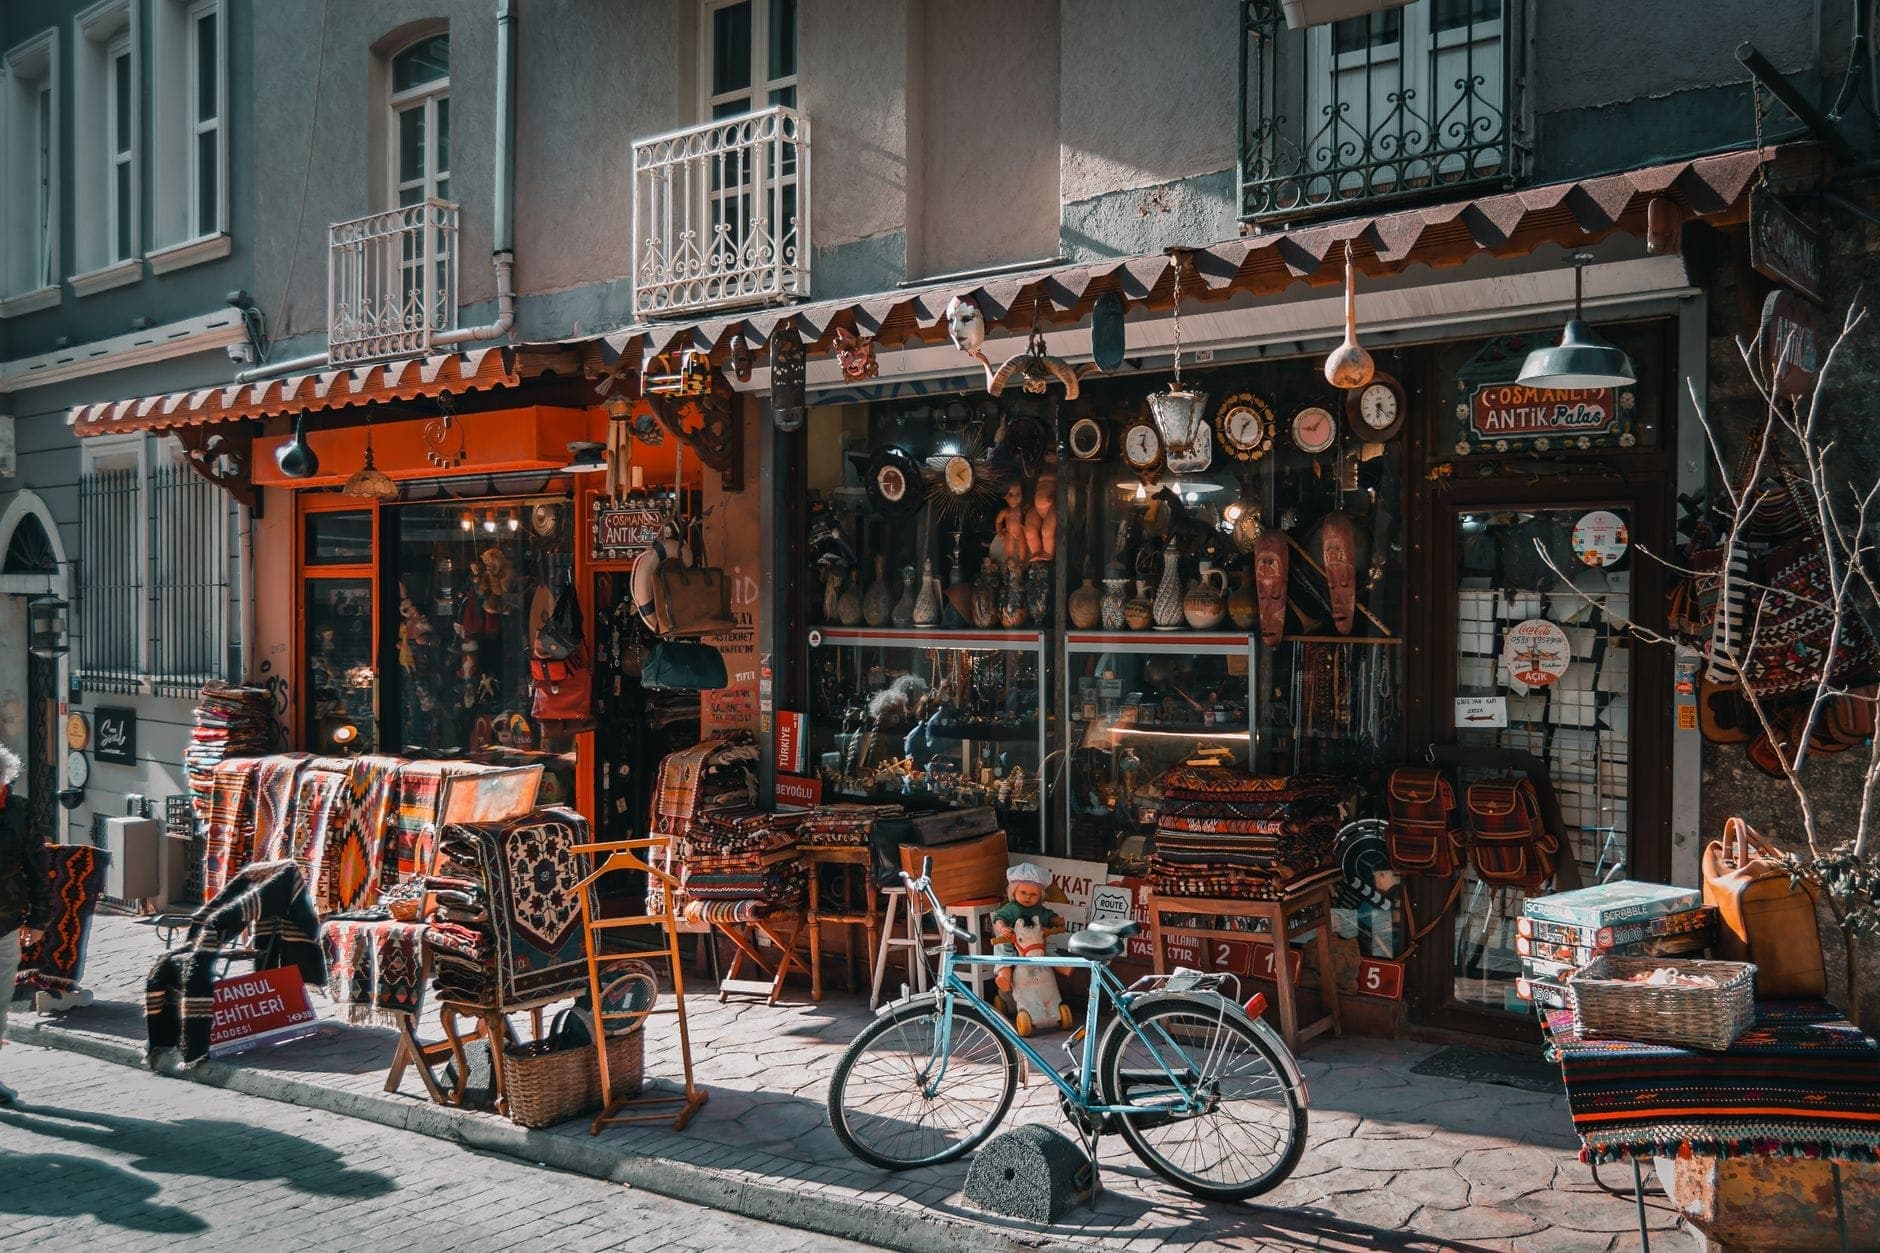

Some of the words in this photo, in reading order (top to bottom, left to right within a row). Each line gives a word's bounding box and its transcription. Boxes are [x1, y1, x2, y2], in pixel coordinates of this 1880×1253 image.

[1551, 404, 1602, 426] Palas
[1525, 672, 1547, 683] AÇIK
[779, 726, 791, 767] TÜRKİYE
[775, 783, 813, 799] BEYOĞLU
[1100, 899, 1124, 910] ROUTE
[1602, 904, 1648, 922] SCRABBLE
[1614, 926, 1643, 944] 2000
[1215, 944, 1231, 966] 2
[1366, 967, 1381, 989] 5
[212, 978, 275, 1004] TANBUL
[210, 995, 285, 1030] EHİTLERİ
